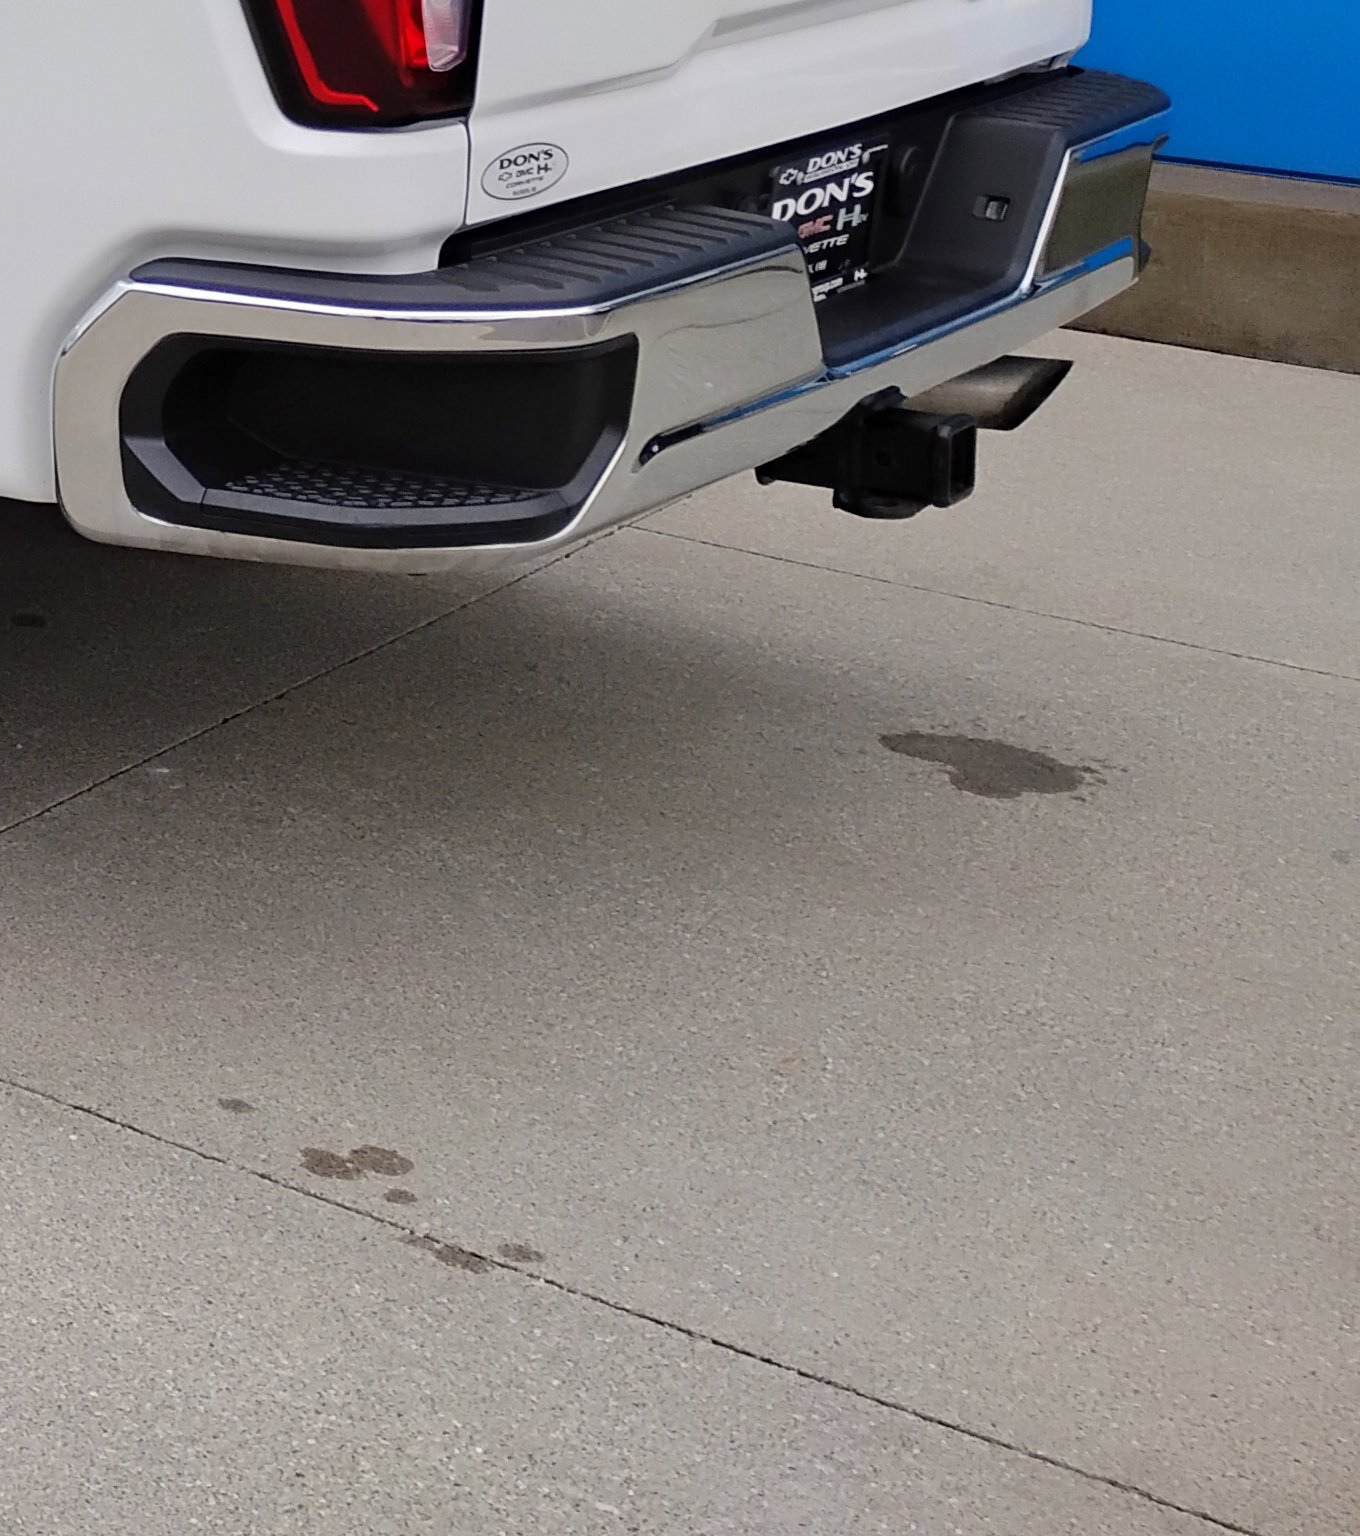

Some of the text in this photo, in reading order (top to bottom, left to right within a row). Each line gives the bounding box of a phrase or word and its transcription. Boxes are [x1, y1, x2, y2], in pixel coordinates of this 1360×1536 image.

[499, 149, 553, 170] DON'S
[807, 143, 863, 172] DON'S
[771, 171, 874, 223] DON'S
